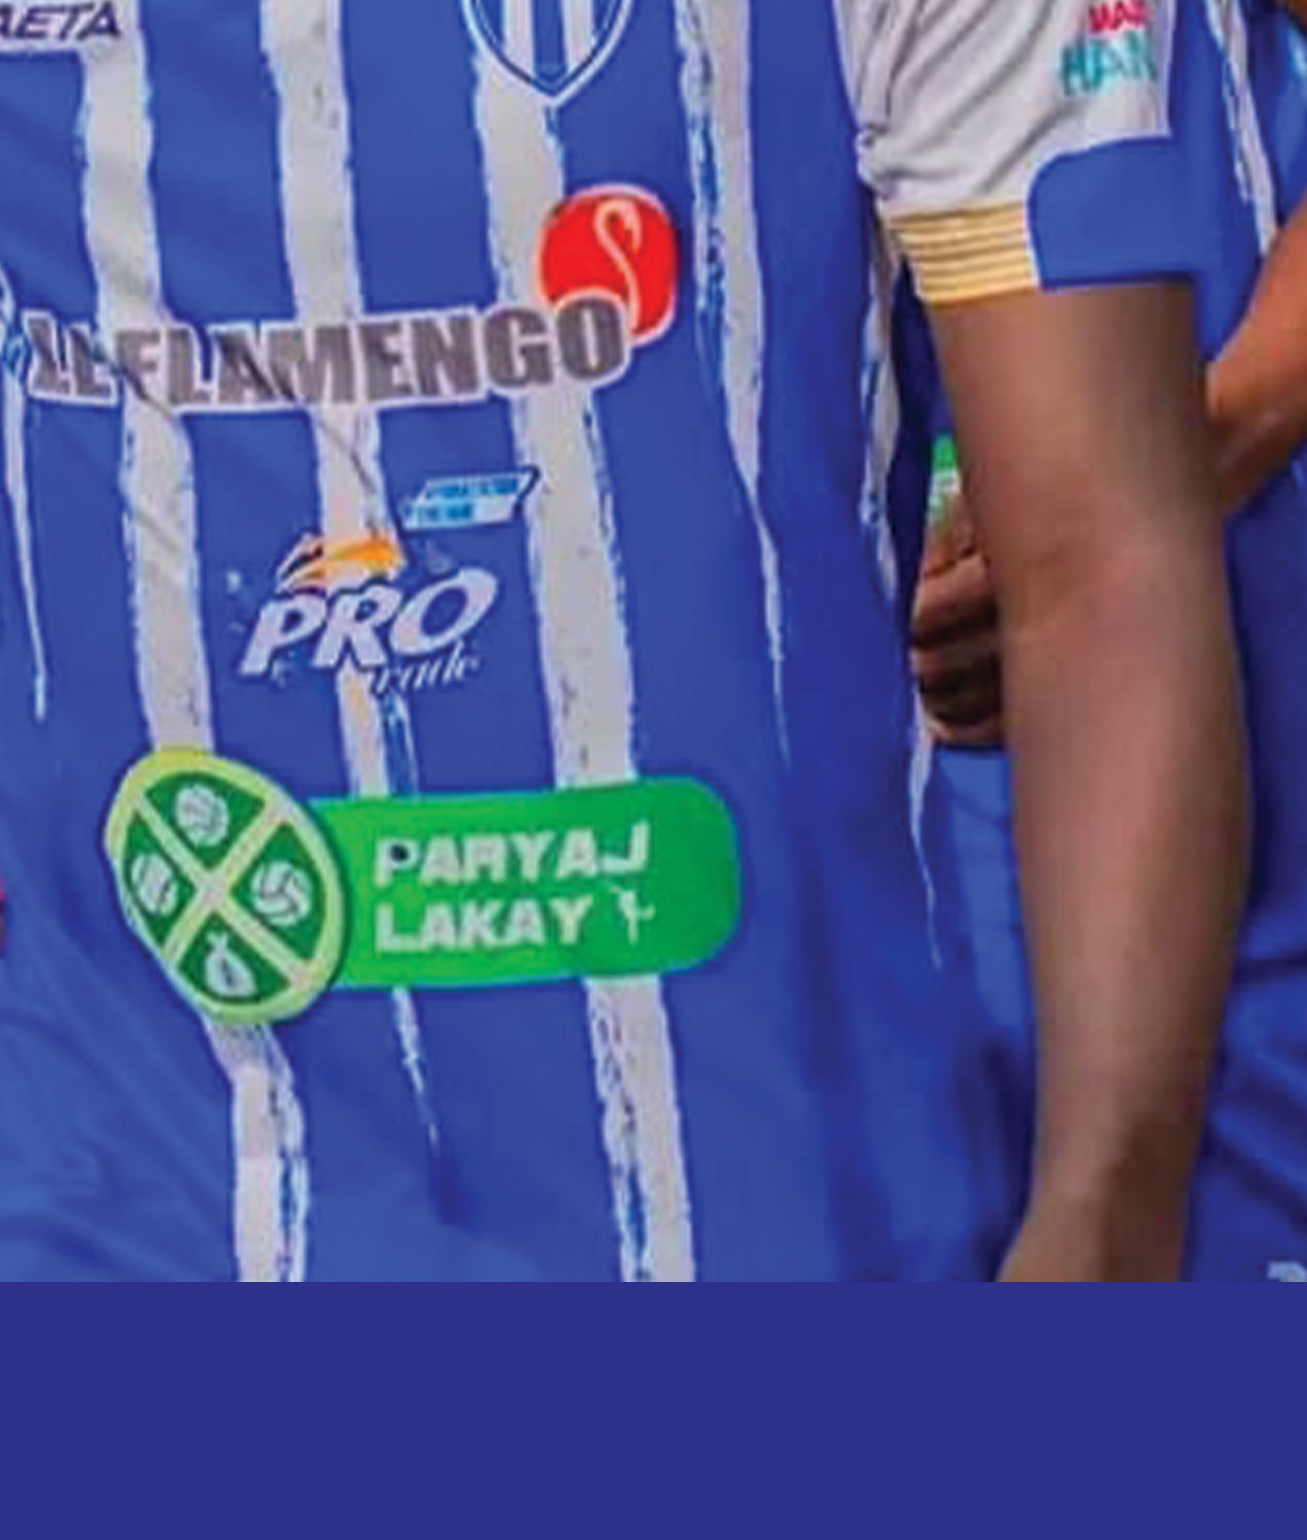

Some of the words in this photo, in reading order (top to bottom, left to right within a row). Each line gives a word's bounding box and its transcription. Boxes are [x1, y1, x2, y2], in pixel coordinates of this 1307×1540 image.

[115, 295, 627, 404] FLAMENGO
[238, 567, 498, 675] PRO
[374, 819, 650, 888] PARYAJ
[374, 896, 596, 954] LAKAY
